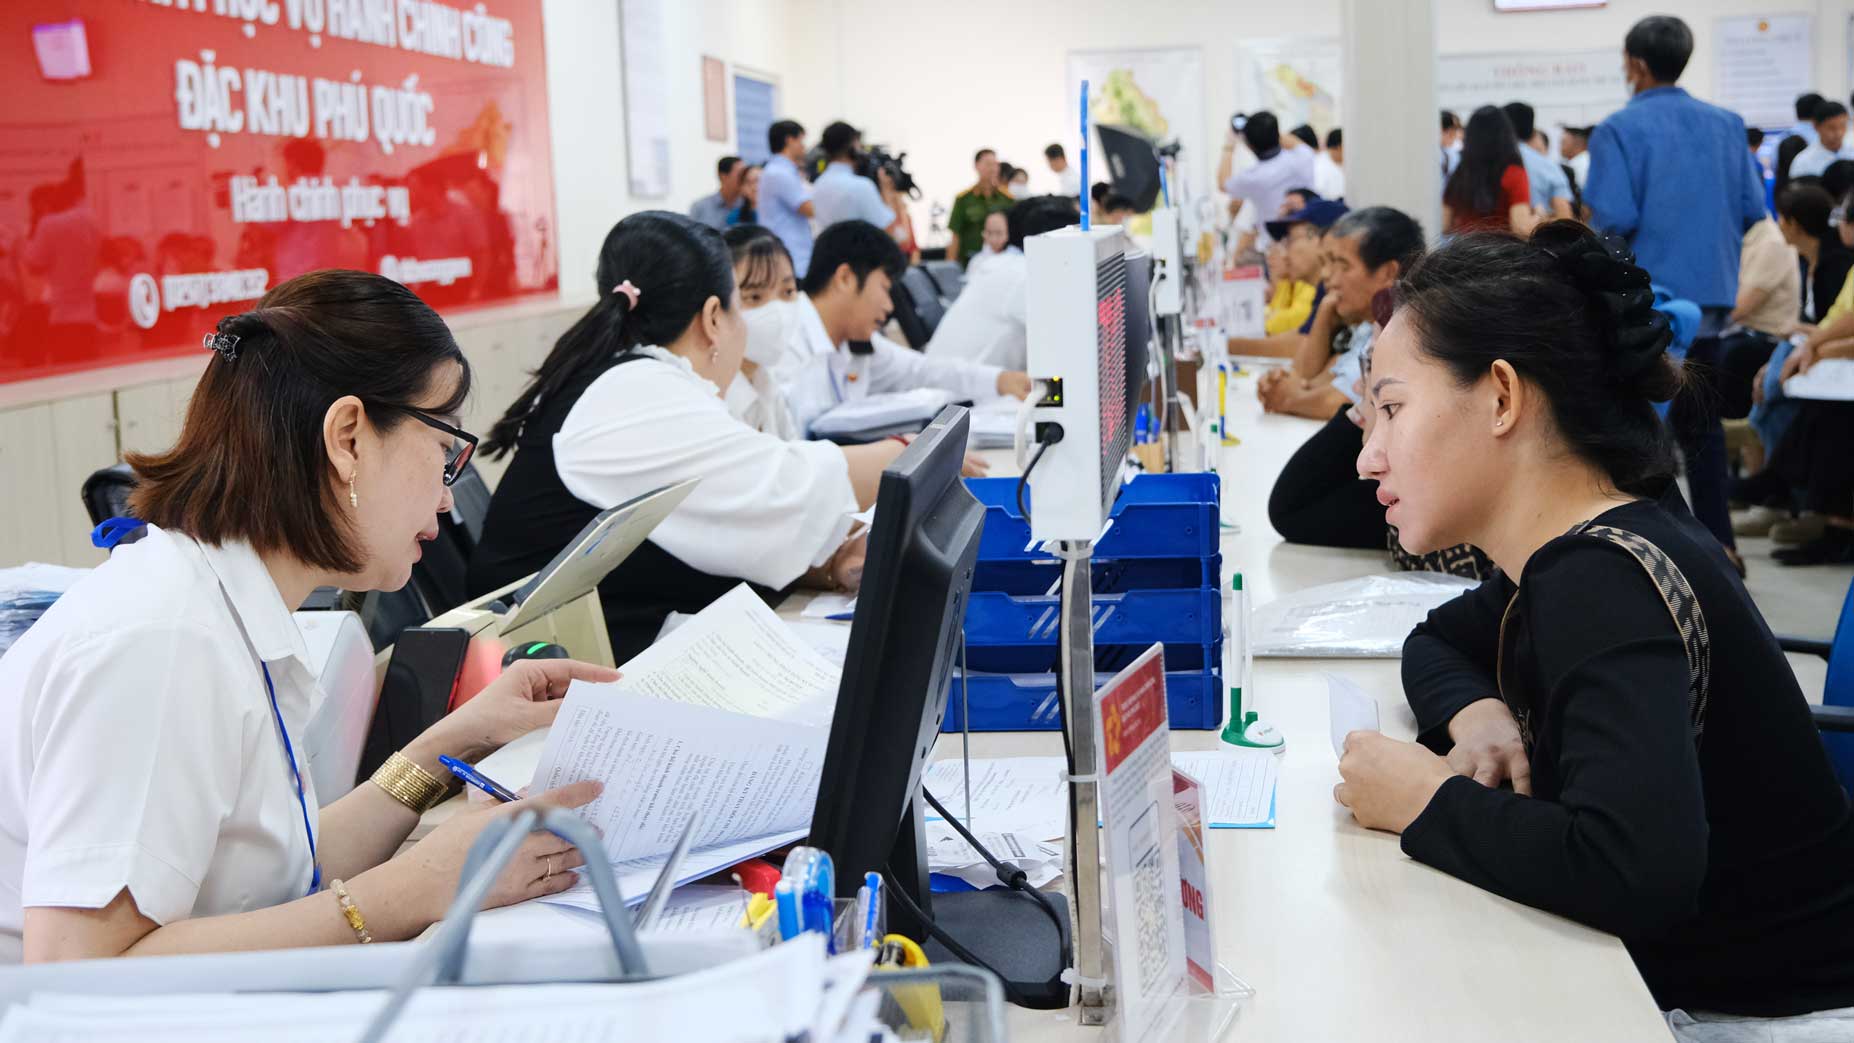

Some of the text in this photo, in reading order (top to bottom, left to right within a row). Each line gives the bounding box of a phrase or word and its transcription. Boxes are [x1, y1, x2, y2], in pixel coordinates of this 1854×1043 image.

[463, 3, 515, 68] CÔNG
[175, 49, 437, 155] ĐẶC KHU PHÚ QUỐC
[230, 175, 411, 229] Hành chính phục vụ
